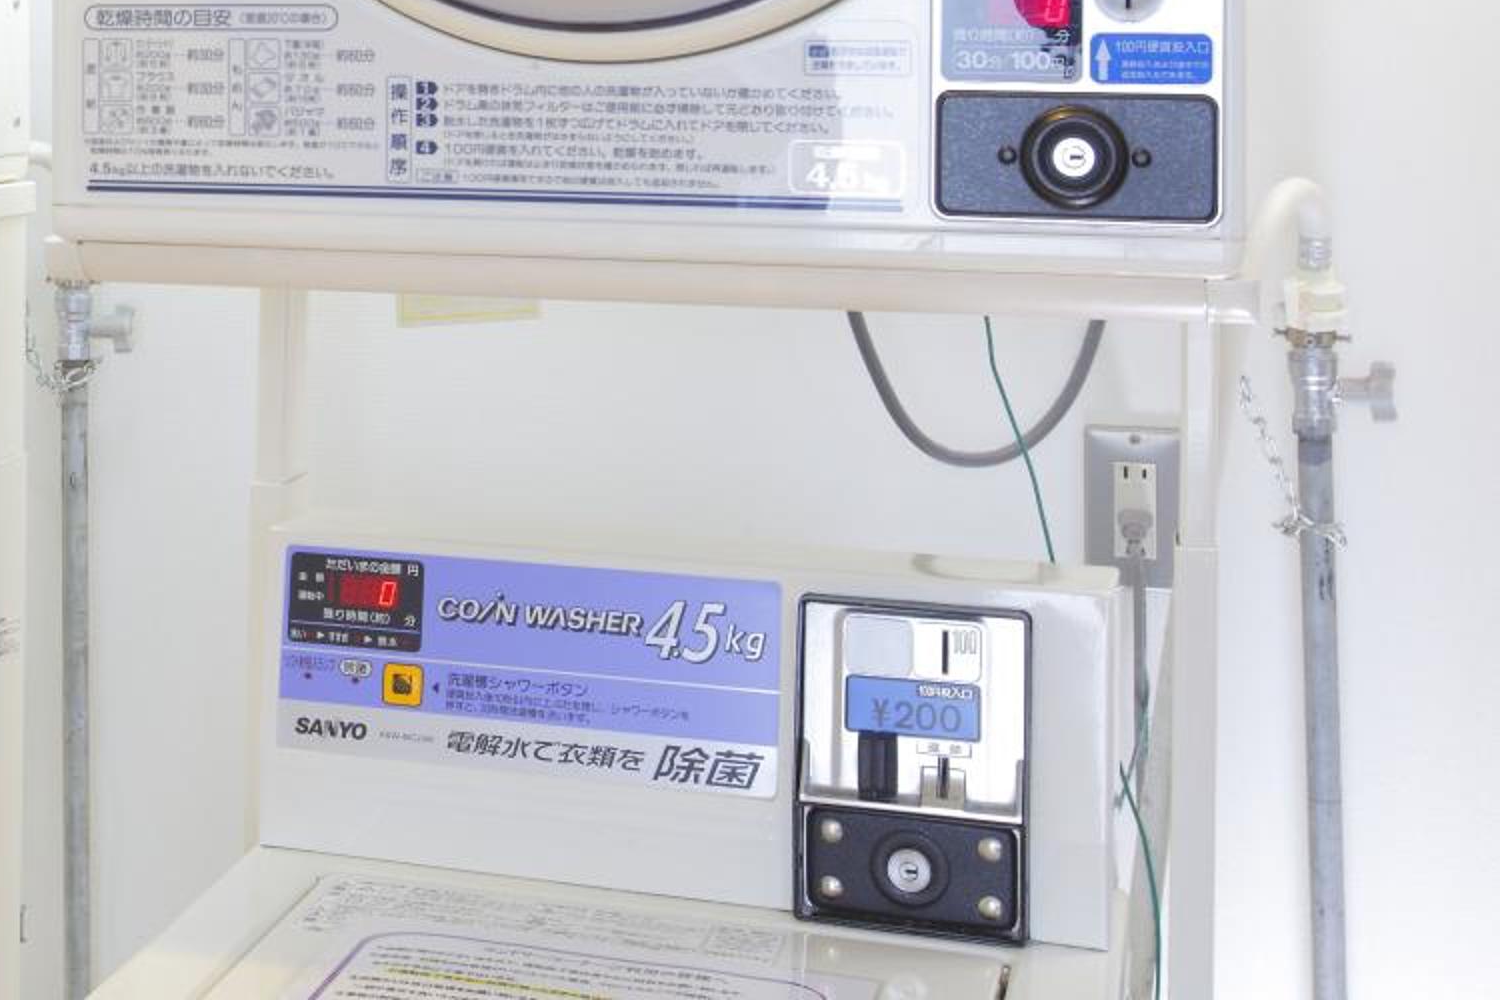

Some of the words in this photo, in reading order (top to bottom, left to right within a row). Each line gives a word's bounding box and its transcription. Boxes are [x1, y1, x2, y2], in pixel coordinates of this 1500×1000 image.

[378, 581, 397, 606] 0
[523, 604, 643, 635] WASHER
[953, 629, 977, 656] 100
[295, 717, 367, 741] SANYO
[873, 697, 962, 734] ¥200
[446, 730, 646, 773] 電解水で衣類を
[652, 744, 765, 791] 除菌
